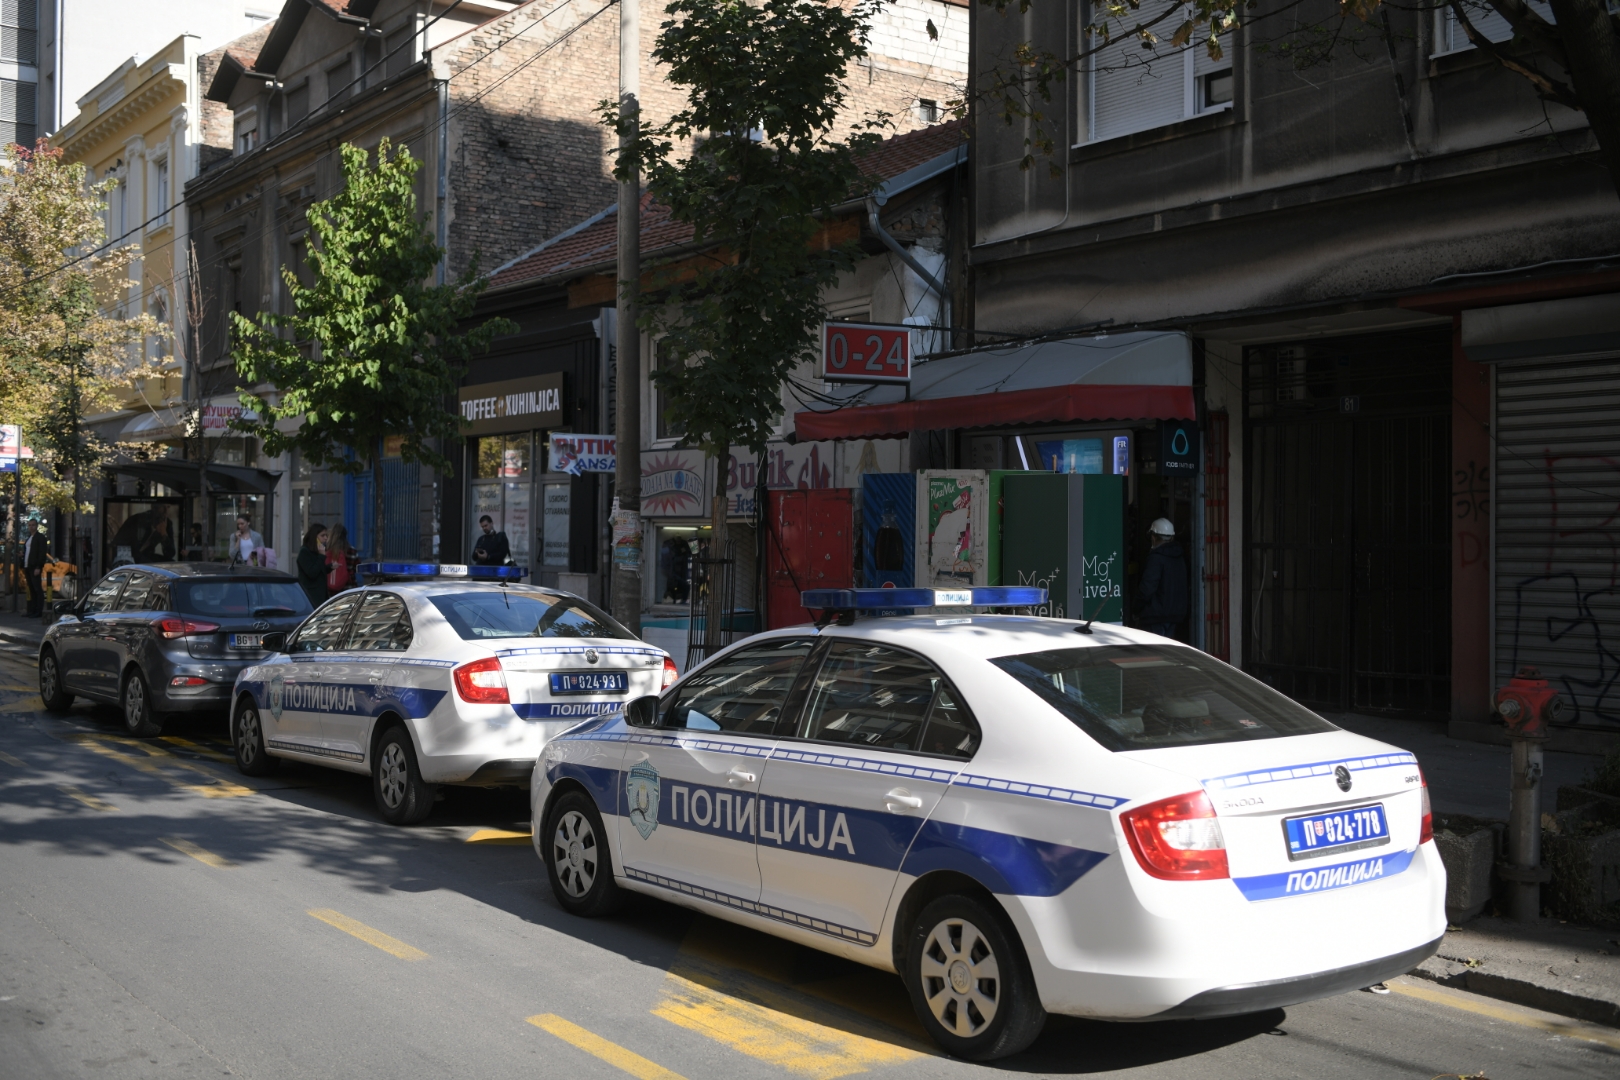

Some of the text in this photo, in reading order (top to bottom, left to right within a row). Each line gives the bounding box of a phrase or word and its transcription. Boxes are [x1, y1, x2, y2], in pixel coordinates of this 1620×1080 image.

[829, 332, 906, 372] 0-24
[461, 397, 497, 421] TOFFEE
[1344, 397, 1354, 412] 81
[726, 449, 795, 491] Buik
[236, 635, 248, 646] BG
[285, 684, 357, 711] ПОЛИЦИЈА
[671, 785, 856, 856] ПОЛИЦИЈА
[1286, 858, 1384, 893] ПОЛИЦИЈА
